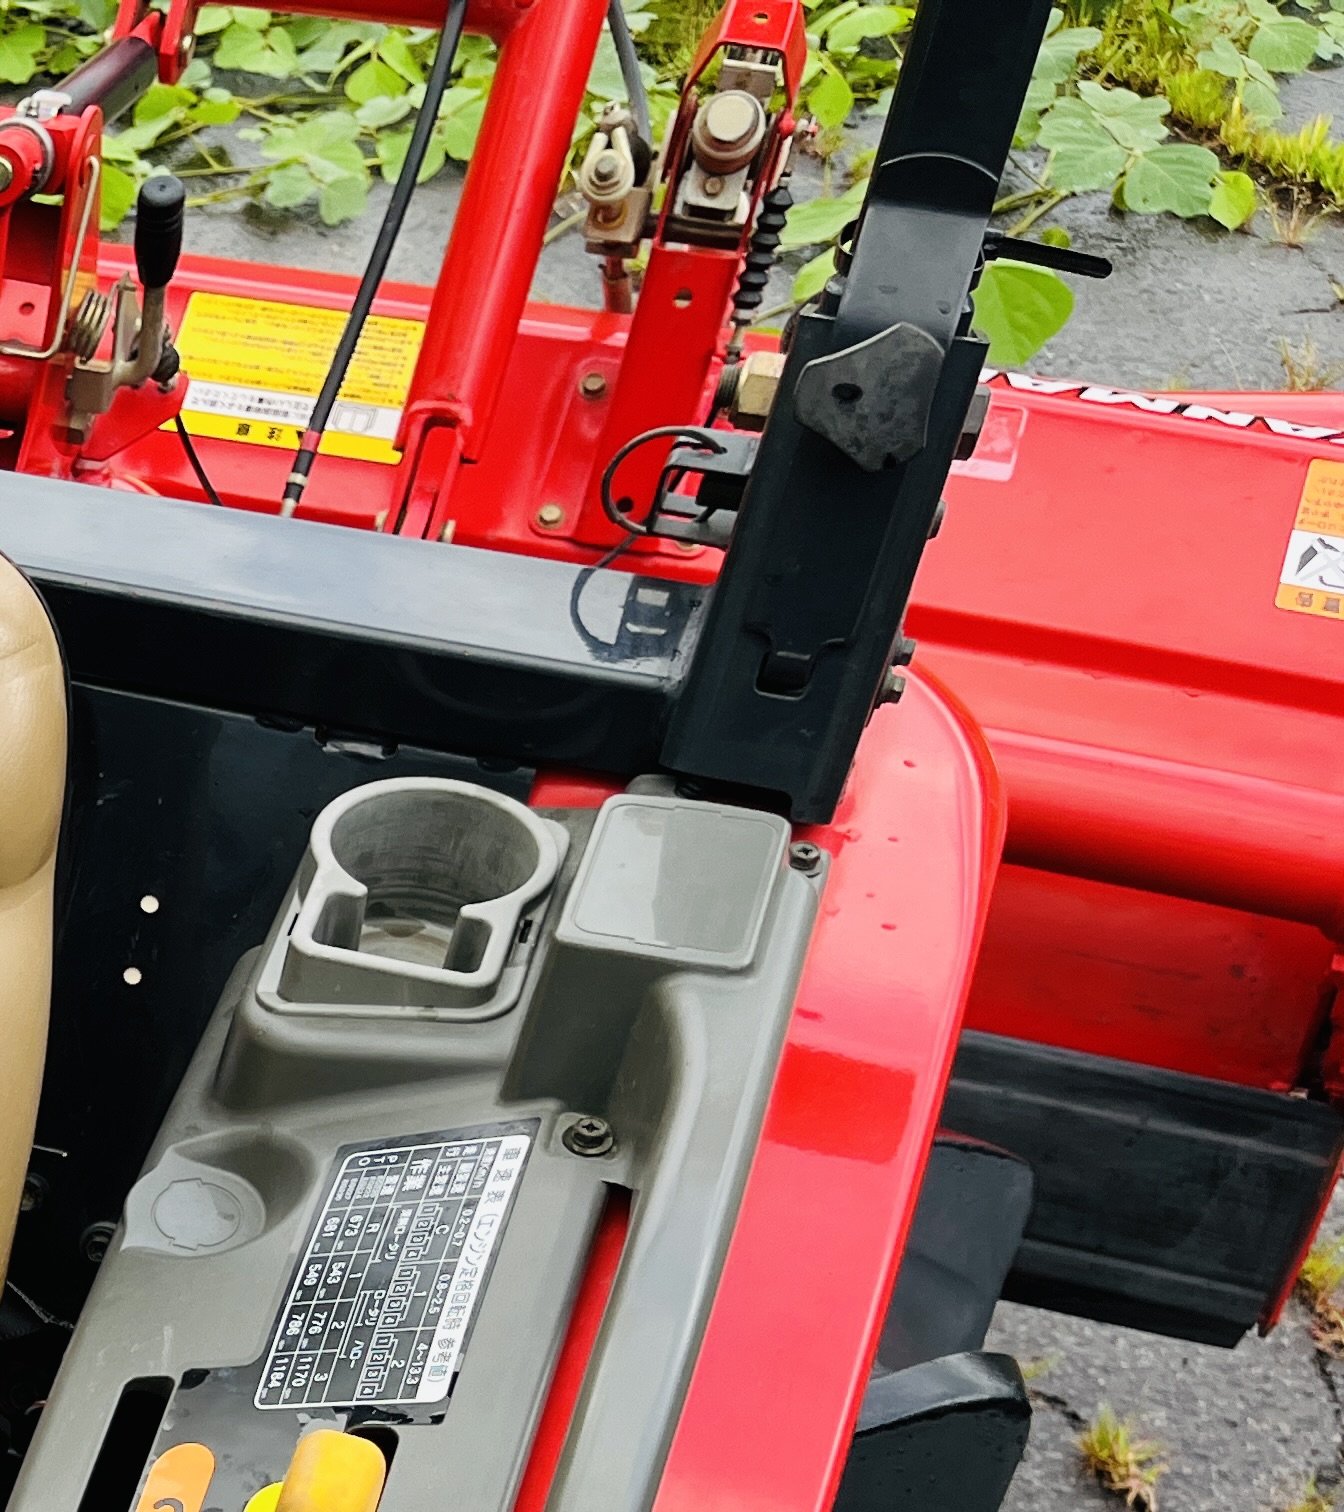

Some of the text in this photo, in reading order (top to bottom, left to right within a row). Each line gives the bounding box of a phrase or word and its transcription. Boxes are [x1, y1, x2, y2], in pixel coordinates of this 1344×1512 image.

[399, 1157, 434, 1192] 作業
[486, 1146, 522, 1203] 車速表
[342, 1213, 365, 1238] 673
[363, 1221, 381, 1234] R
[433, 1222, 451, 1236] C
[324, 1260, 347, 1285] 543
[347, 1270, 363, 1280] 1
[364, 1290, 386, 1325] ロータリ
[305, 1310, 330, 1335] 776
[329, 1319, 346, 1330] 2
[288, 1356, 316, 1387] 1170
[388, 1358, 406, 1369] 2
[311, 1371, 329, 1382] 3
